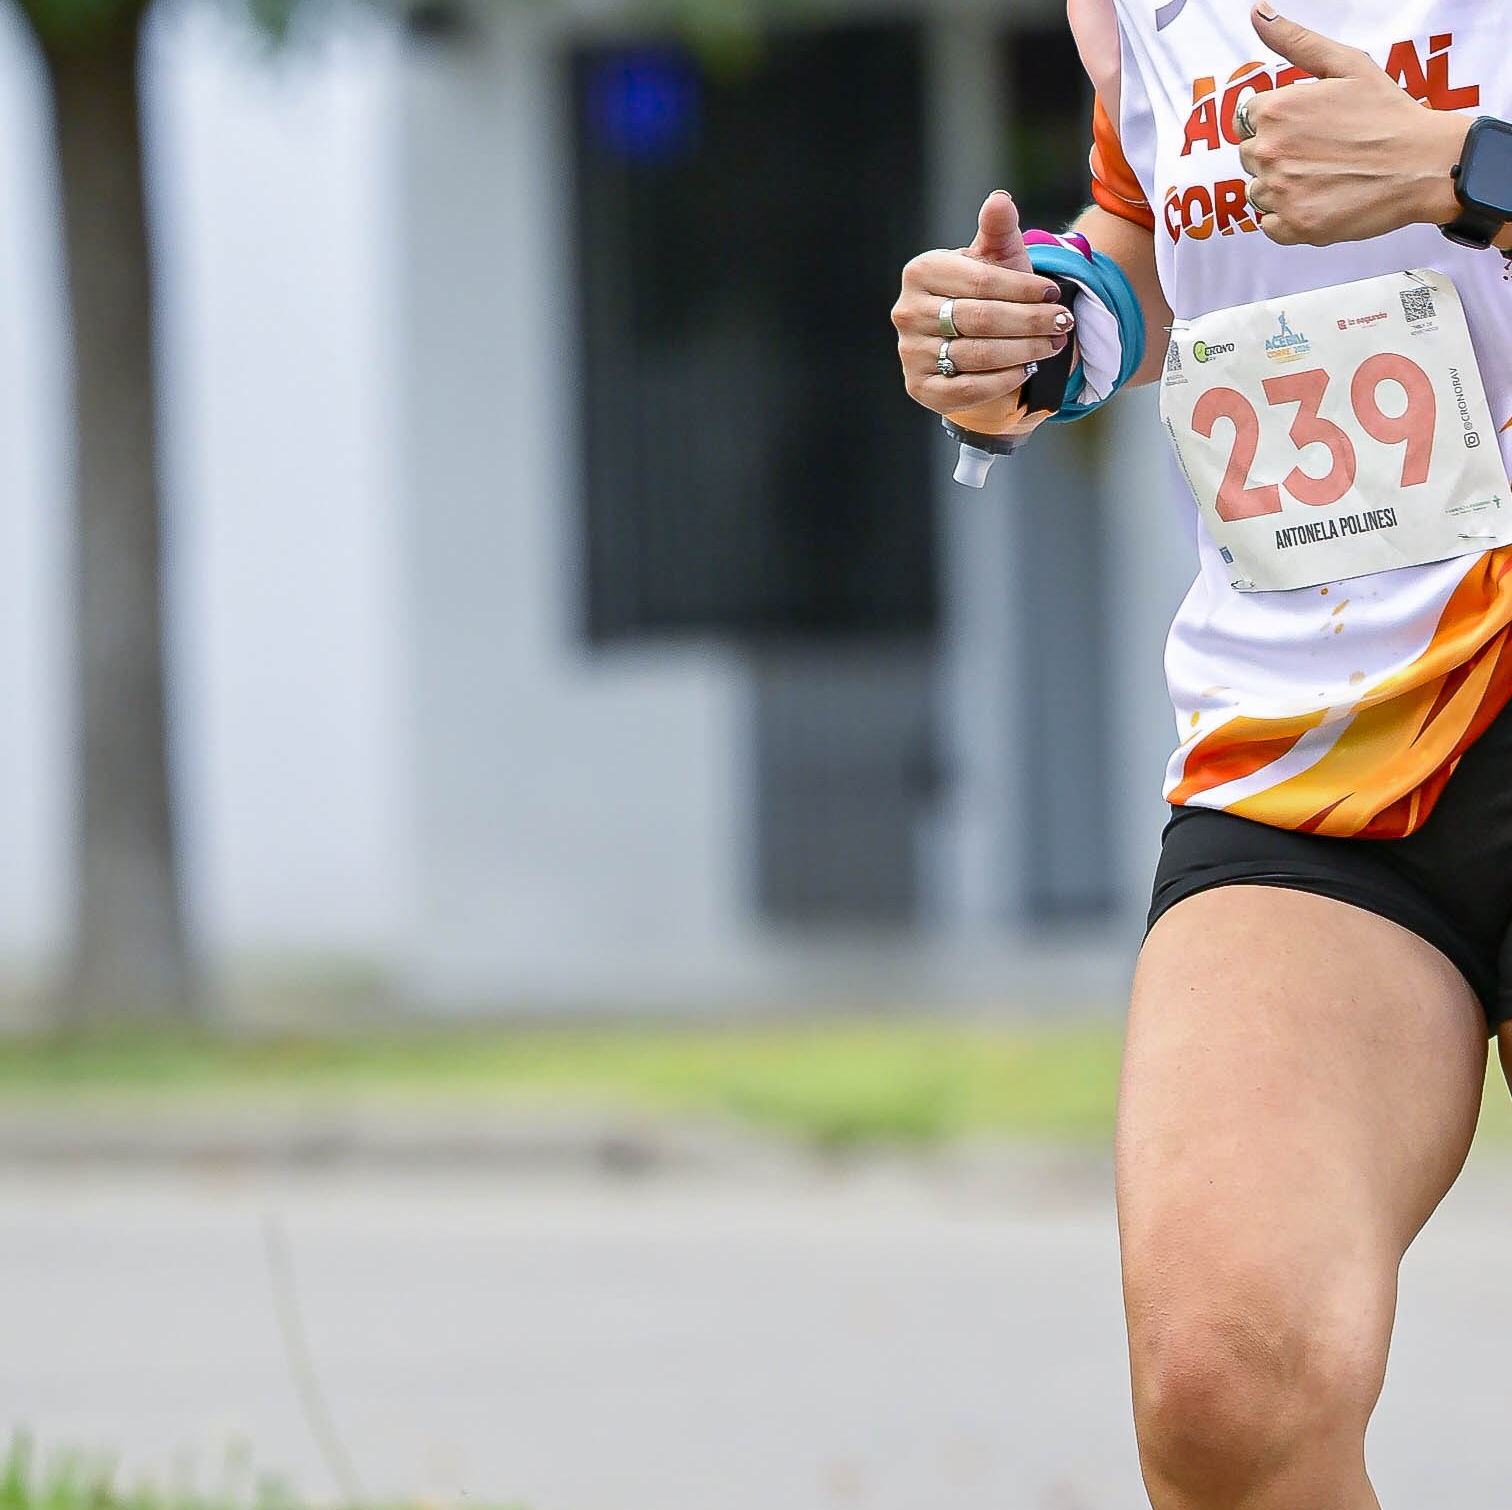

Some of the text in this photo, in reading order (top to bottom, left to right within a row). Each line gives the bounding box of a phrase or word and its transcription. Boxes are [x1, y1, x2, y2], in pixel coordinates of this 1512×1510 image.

[1448, 367, 1474, 431] @CRONORAV
[1191, 352, 1436, 523] 239
[1275, 507, 1398, 550] ANTONELA POLINESI
